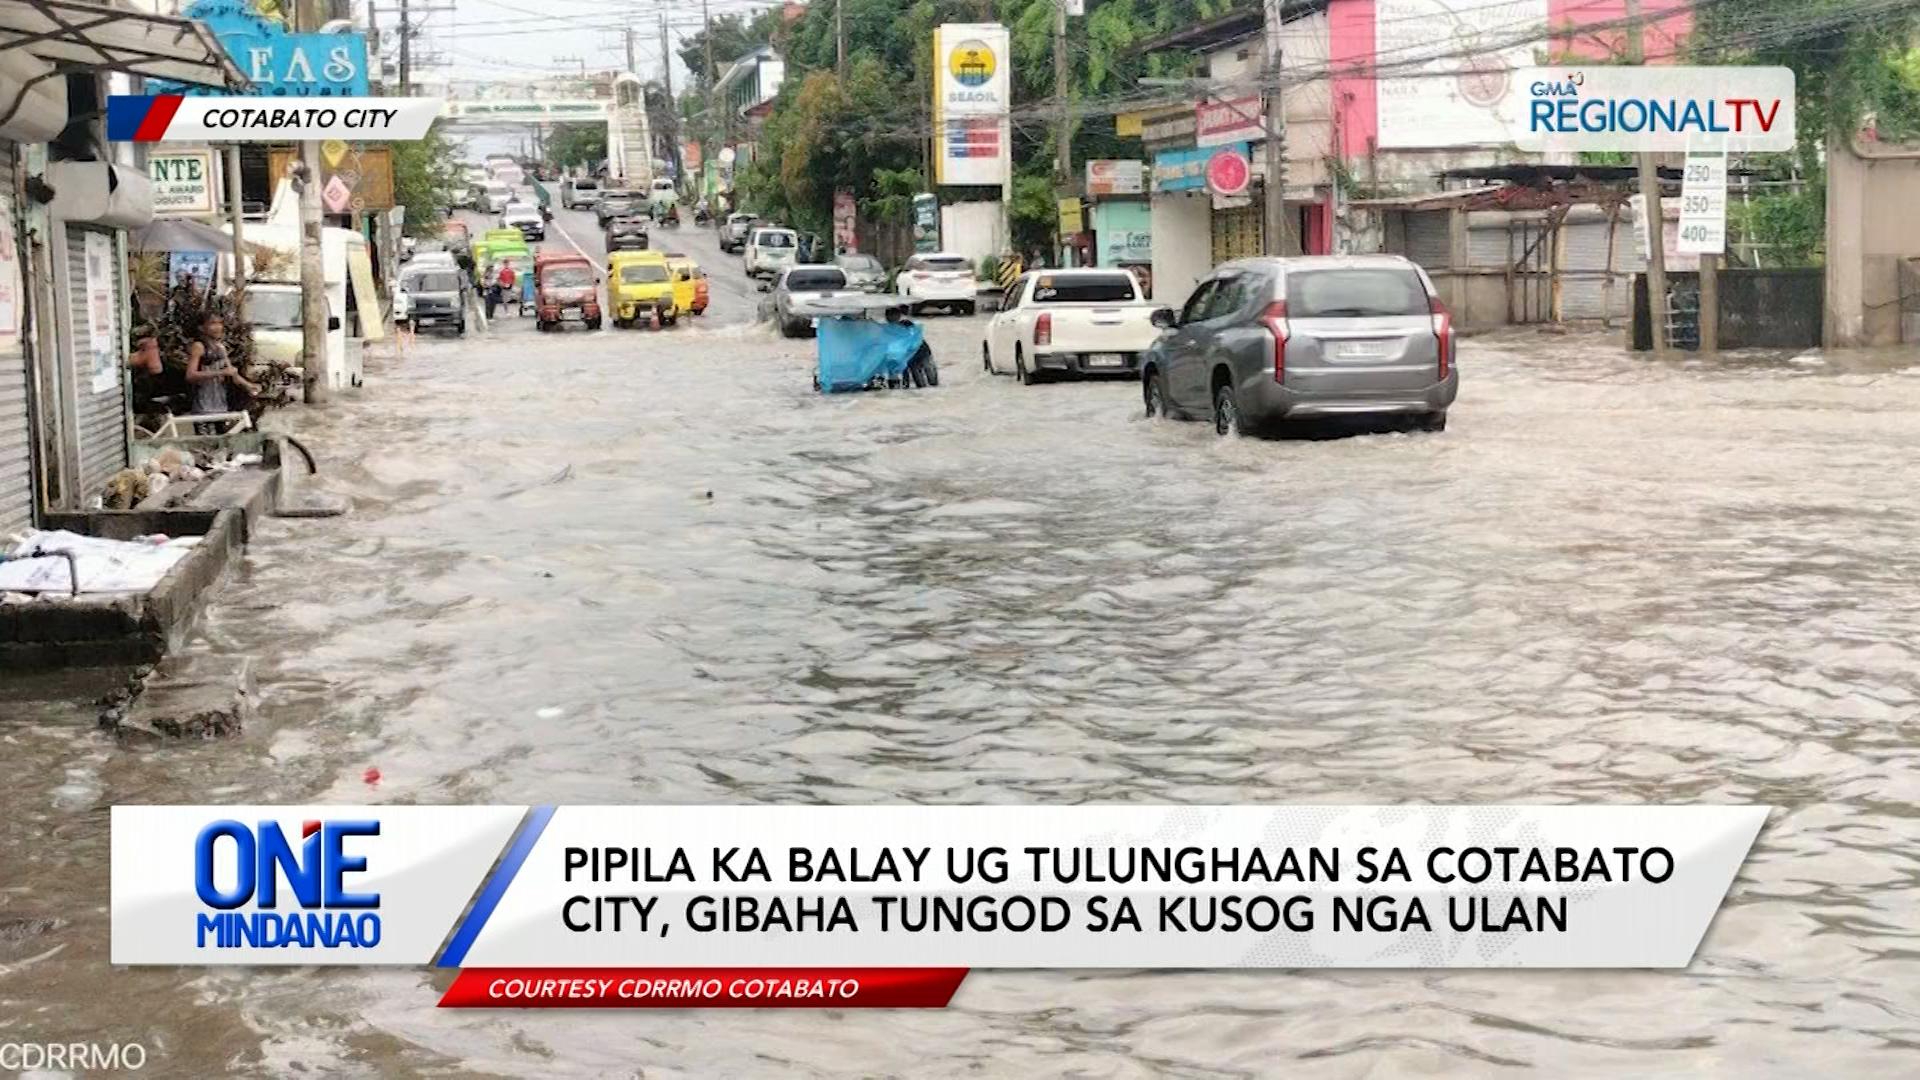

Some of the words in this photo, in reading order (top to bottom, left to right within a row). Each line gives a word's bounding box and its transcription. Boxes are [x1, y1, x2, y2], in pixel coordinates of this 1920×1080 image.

[948, 91, 998, 103] SEAOIL
[1687, 165, 1710, 181] 250
[1681, 226, 1707, 242] 400
